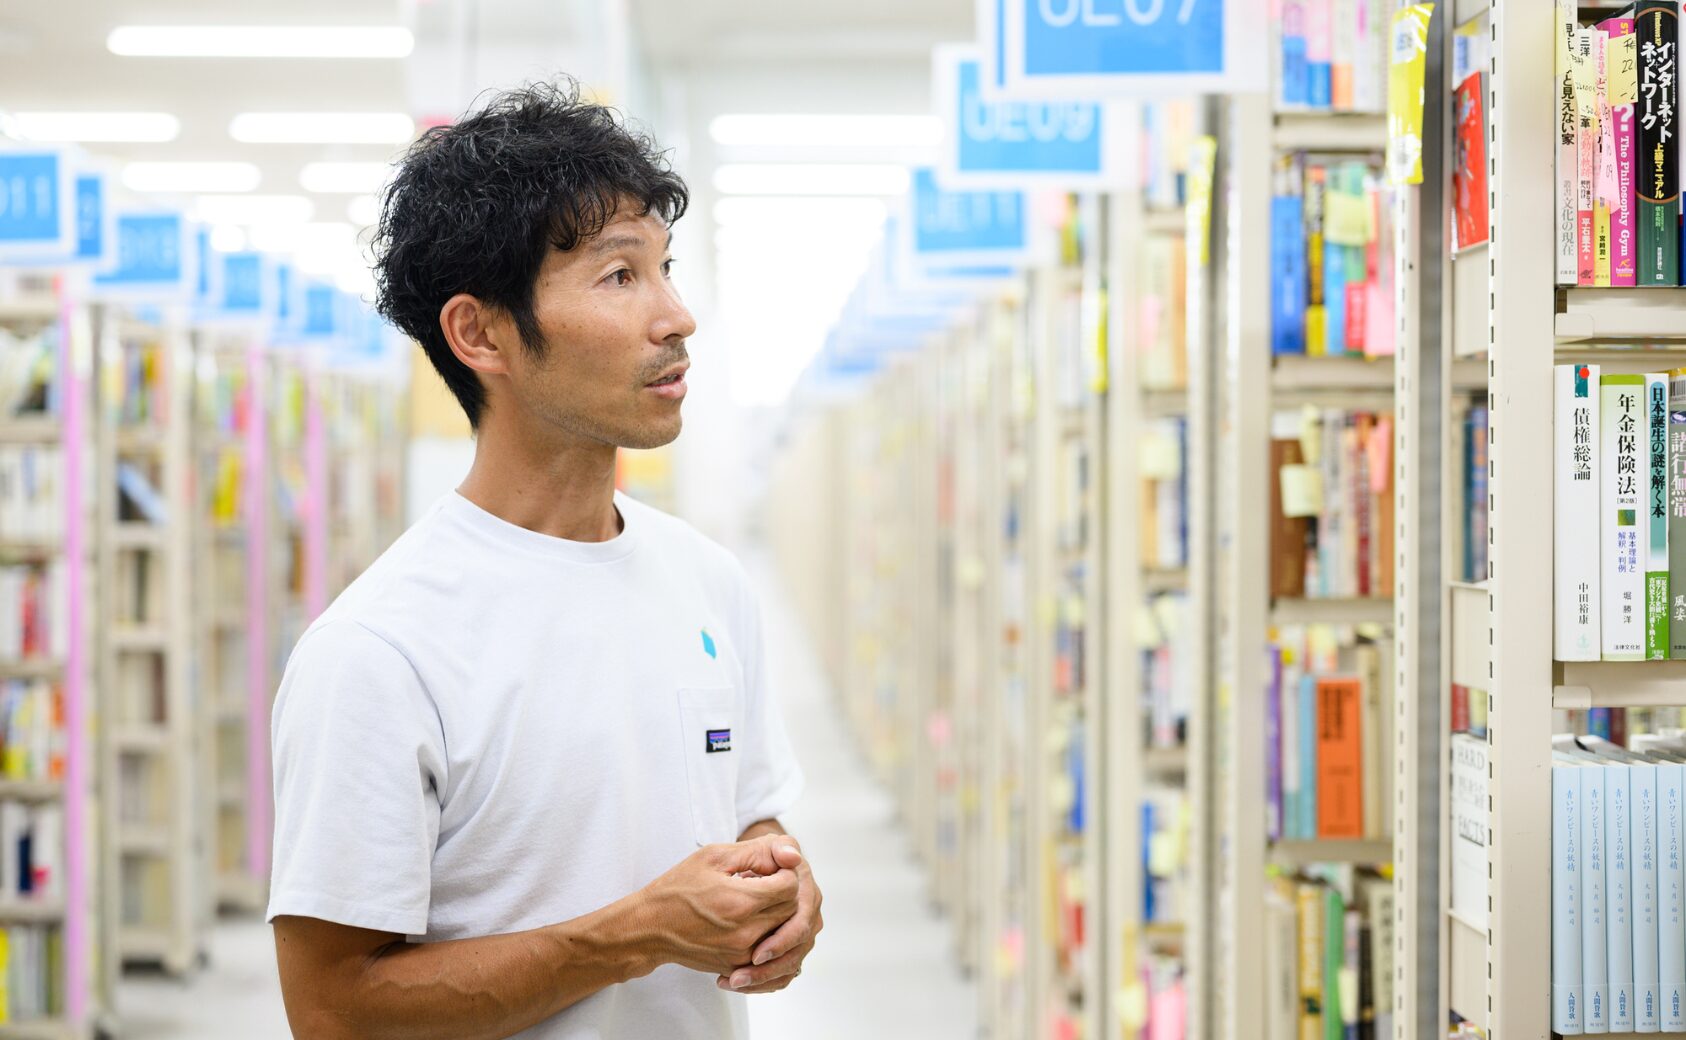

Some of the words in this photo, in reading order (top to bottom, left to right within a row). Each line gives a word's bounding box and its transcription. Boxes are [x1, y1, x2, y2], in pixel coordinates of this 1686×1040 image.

[1640, 41, 1658, 130] ネットワーク
[1657, 42, 1674, 143] インターネット
[1621, 136, 1630, 158] The
[1654, 142, 1665, 199] 上級マニュアル
[1619, 161, 1630, 226] Philosophy
[1619, 230, 1630, 257] Gym
[1573, 407, 1591, 481] 債権総論
[1617, 393, 1636, 495] 年金保険法
[1651, 387, 1665, 518] 日本誕生の謎を解く本
[1618, 532, 1627, 573] 解釈・判例
[1628, 532, 1636, 573] 基本理論と
[1578, 582, 1589, 625] 中田裕康
[1566, 788, 1575, 871] 青いワンピースの妖精
[1591, 788, 1600, 870] 青いワンピースの妖精
[1615, 788, 1624, 870] 青いワンピースの妖精
[1642, 788, 1652, 870] 青いワンピースの妖精
[1668, 787, 1678, 870] 青いワンピースの妖精
